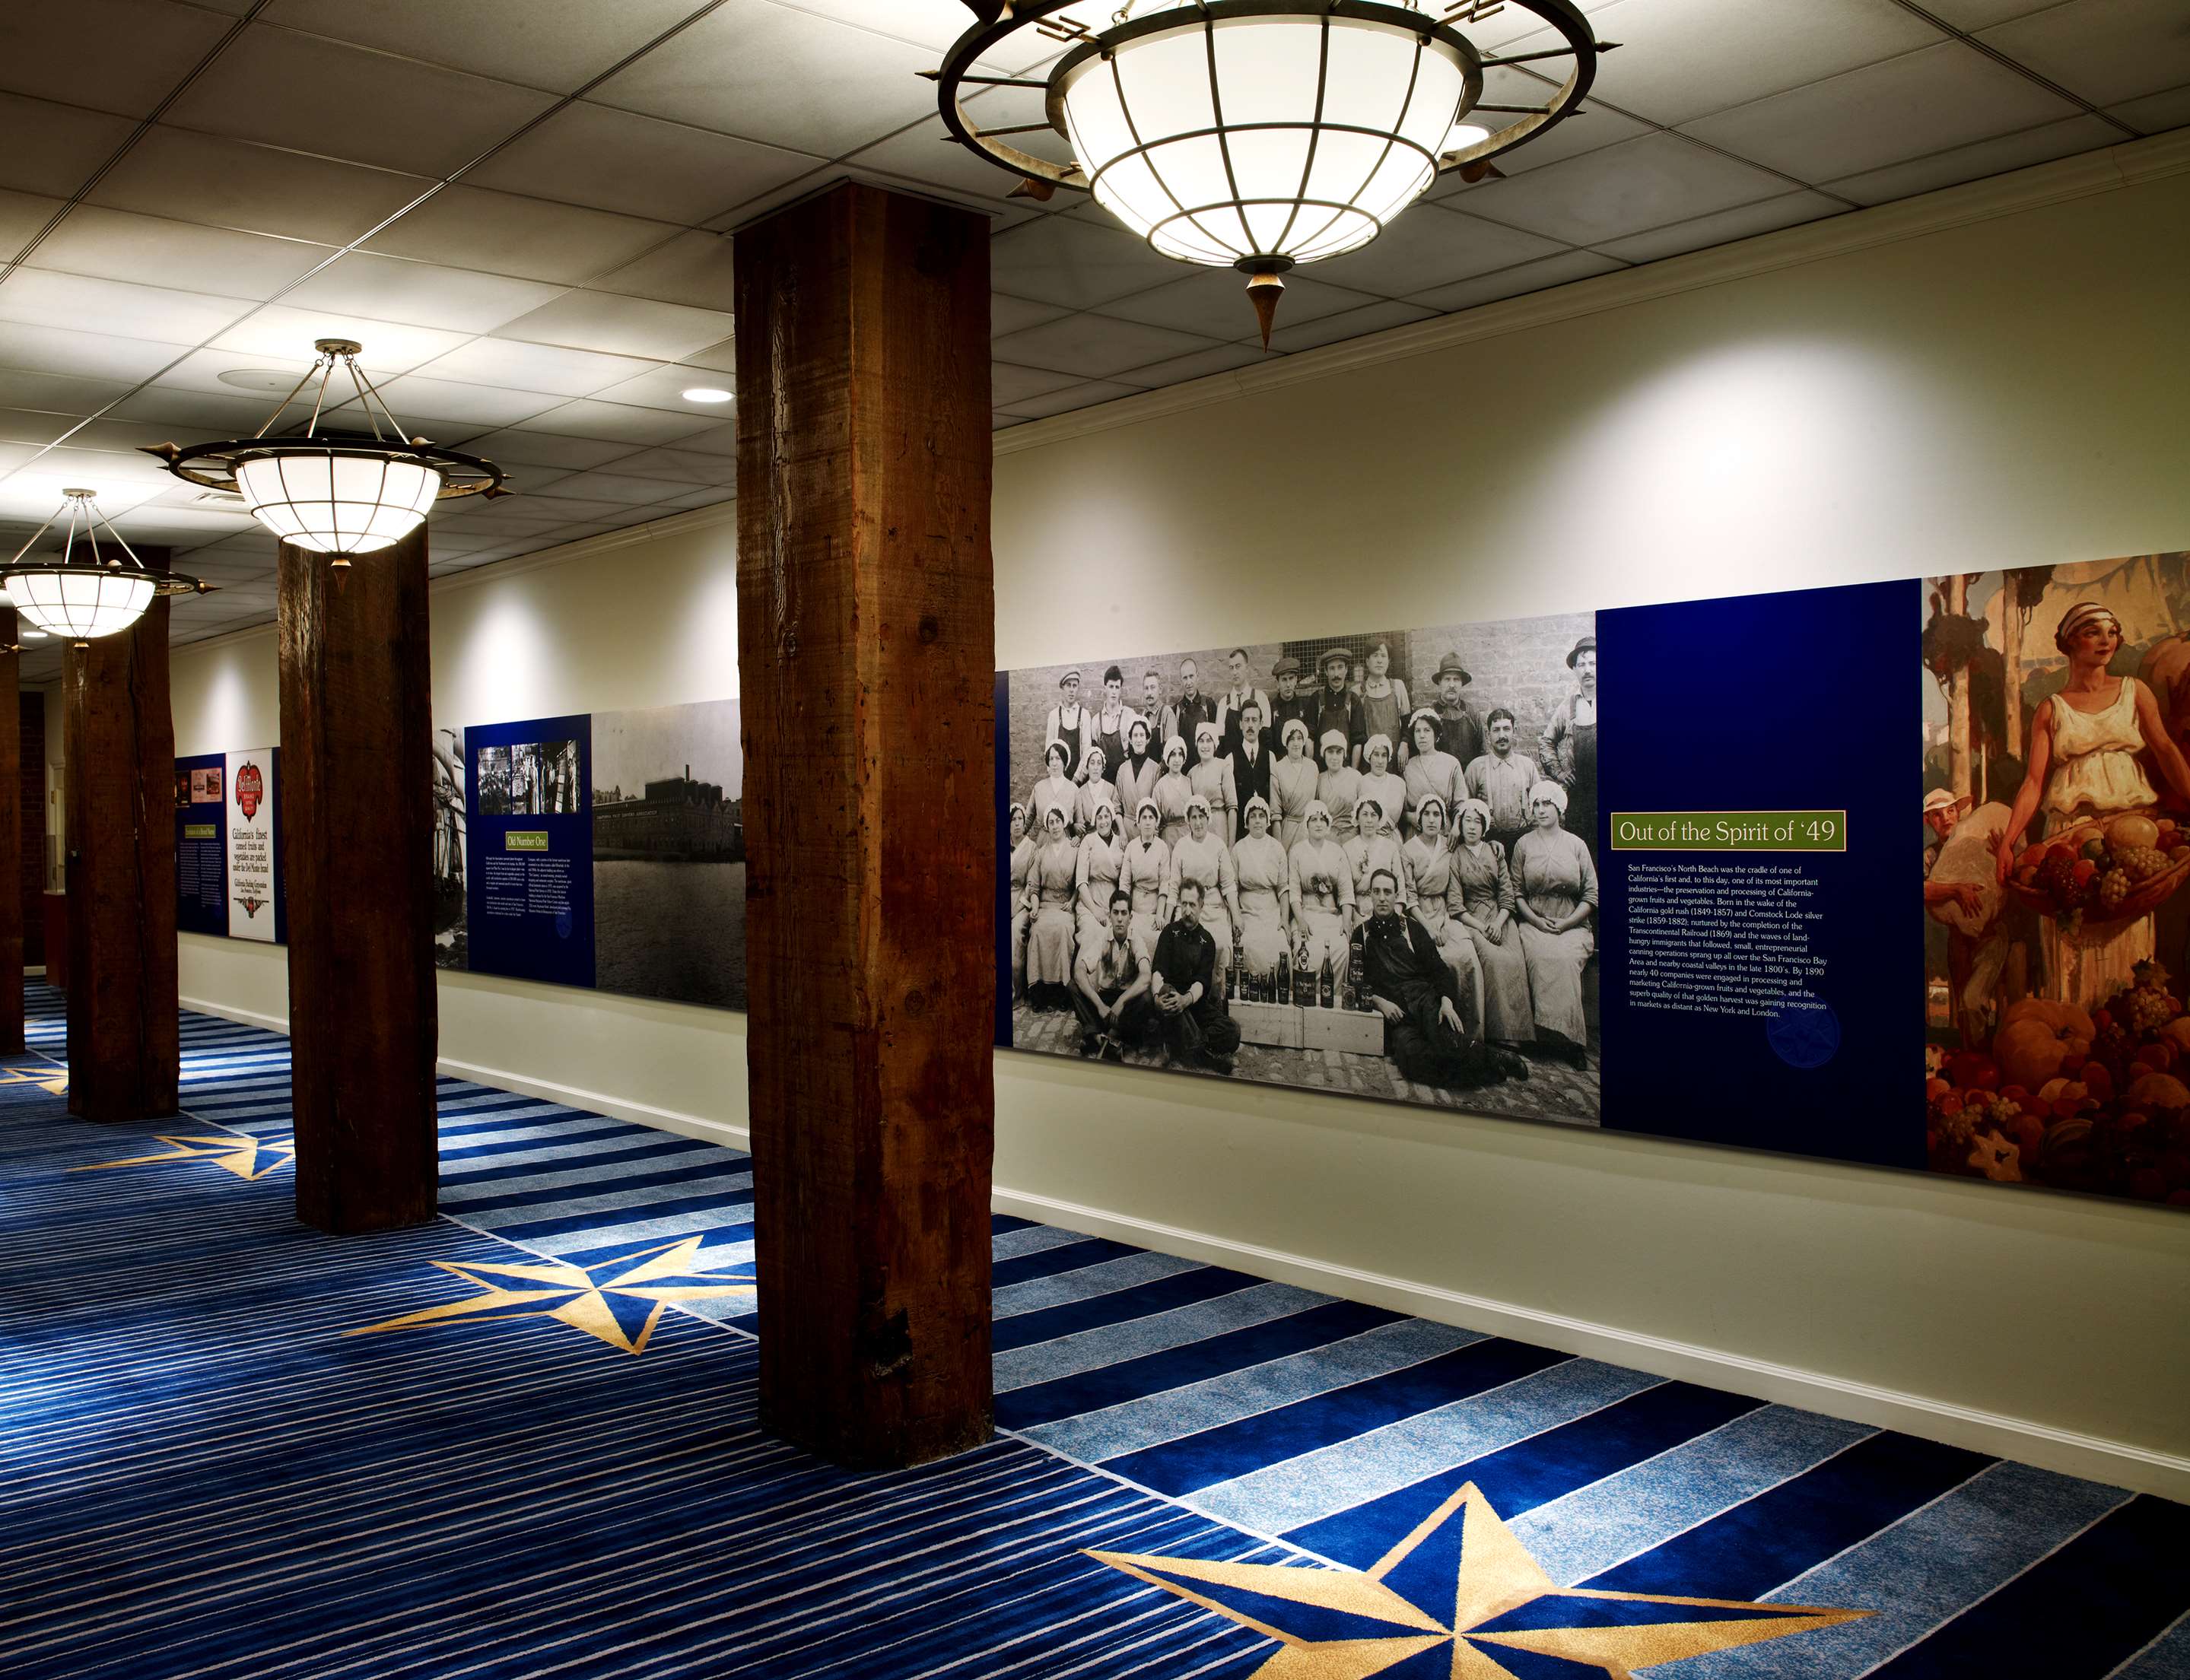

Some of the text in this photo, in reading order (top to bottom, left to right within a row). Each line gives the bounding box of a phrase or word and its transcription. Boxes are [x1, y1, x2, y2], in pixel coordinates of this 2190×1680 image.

[233, 827, 268, 840] California's finest
[1619, 820, 1835, 845] Out of the Spirit of '49
[507, 836, 546, 846] Old Number One
[1716, 876, 1730, 885] day,
[1680, 897, 1715, 906] vegetables.
[1691, 908, 1733, 916] (1849-1857)
[1749, 910, 1783, 918] Comstock
[1720, 919, 1728, 928] by
[1742, 921, 1780, 929] completion
[1629, 926, 1680, 935] Transcontinental
[1710, 930, 1732, 938] (1869)
[1629, 937, 1650, 946] hungry
[1703, 940, 1732, 949] followed,
[1778, 955, 1811, 964] Francisco
[1813, 957, 1827, 966] Bay
[1629, 969, 1648, 977] nearly
[1660, 972, 1694, 980] companies
[1705, 963, 1727, 971] valleys
[1765, 965, 1790, 973] 1800's.
[1793, 967, 1802, 976] By
[1629, 980, 1660, 988] marketing
[1661, 980, 1715, 992] California-grown
[1749, 986, 1786, 996] vegetables,
[1651, 991, 1672, 999] quality
[1760, 999, 1785, 1008] gaining
[1787, 1002, 1826, 1010] recognition
[1752, 1008, 1780, 1017] London.
